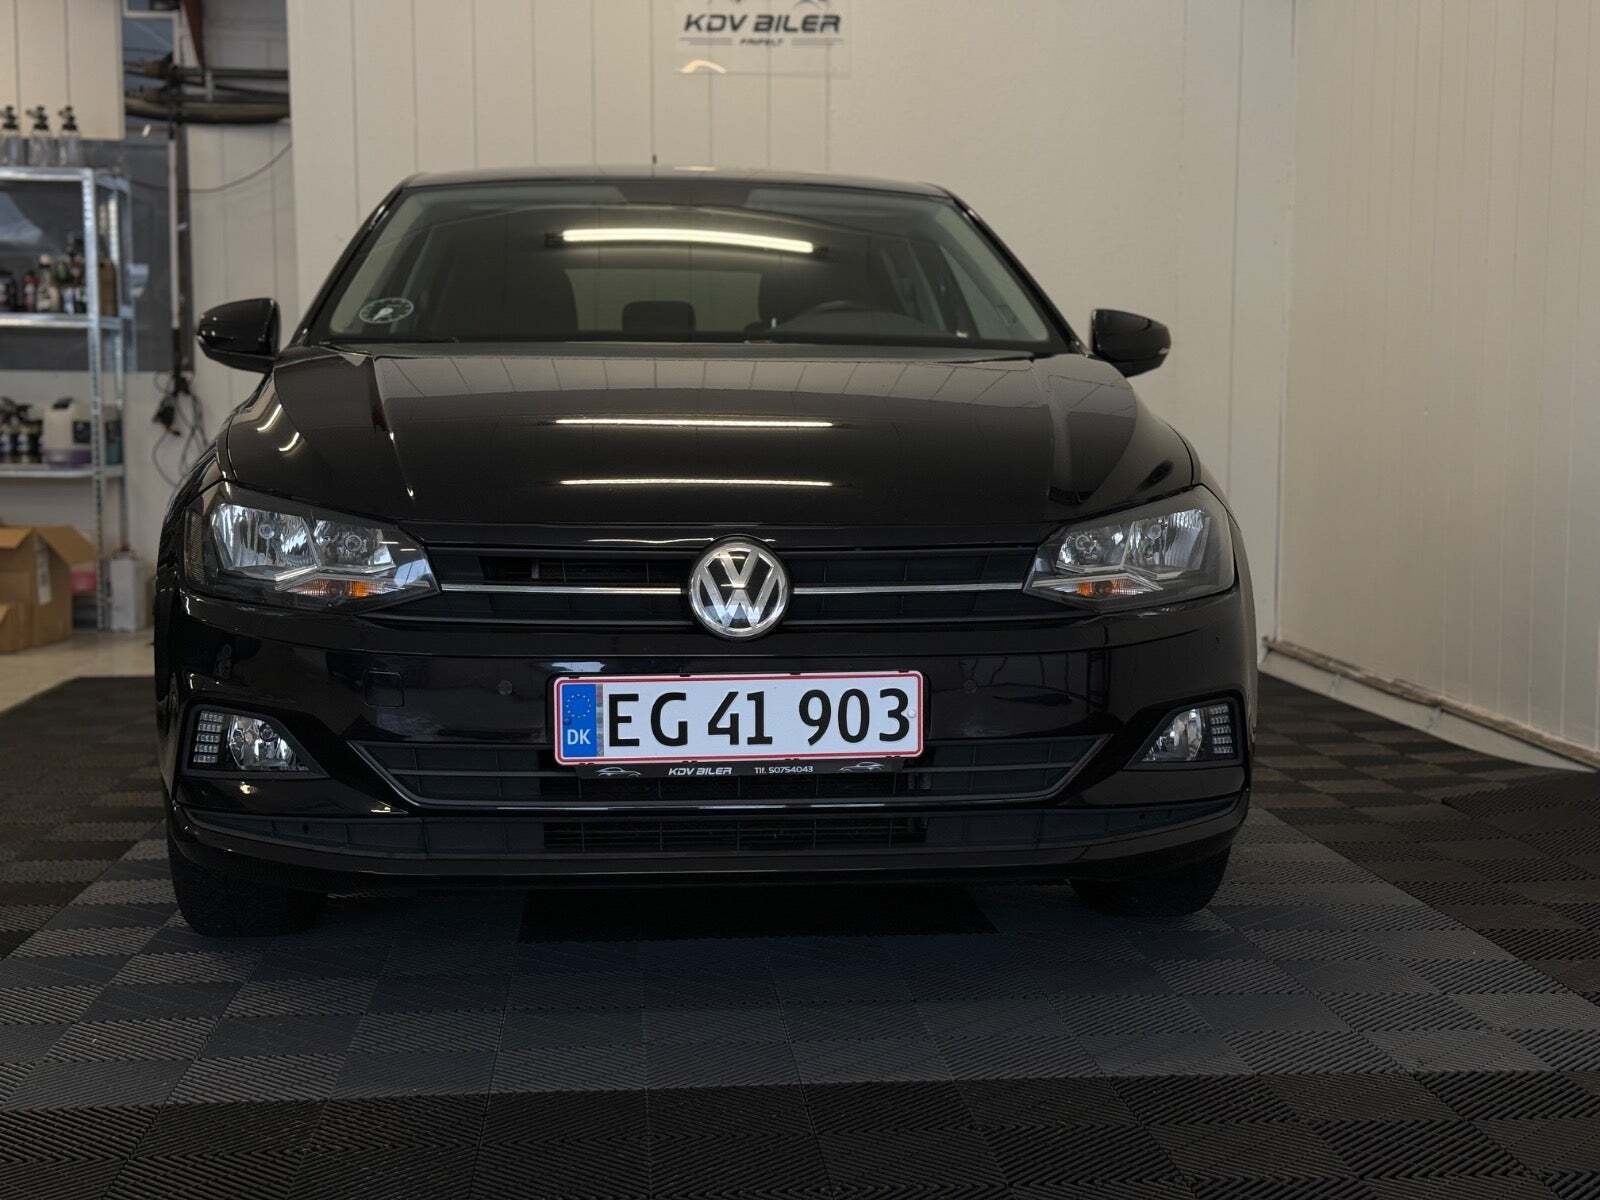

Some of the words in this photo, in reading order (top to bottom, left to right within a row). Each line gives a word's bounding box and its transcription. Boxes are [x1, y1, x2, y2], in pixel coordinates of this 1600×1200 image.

[684, 14, 747, 32] KDV
[754, 14, 841, 33] BILER
[608, 691, 688, 747] EG
[707, 691, 773, 746] 41
[798, 687, 911, 746] 903
[567, 729, 591, 745] DK
[668, 767, 695, 776] KDV
[696, 767, 732, 776] BILER
[768, 766, 814, 775] 50754043
